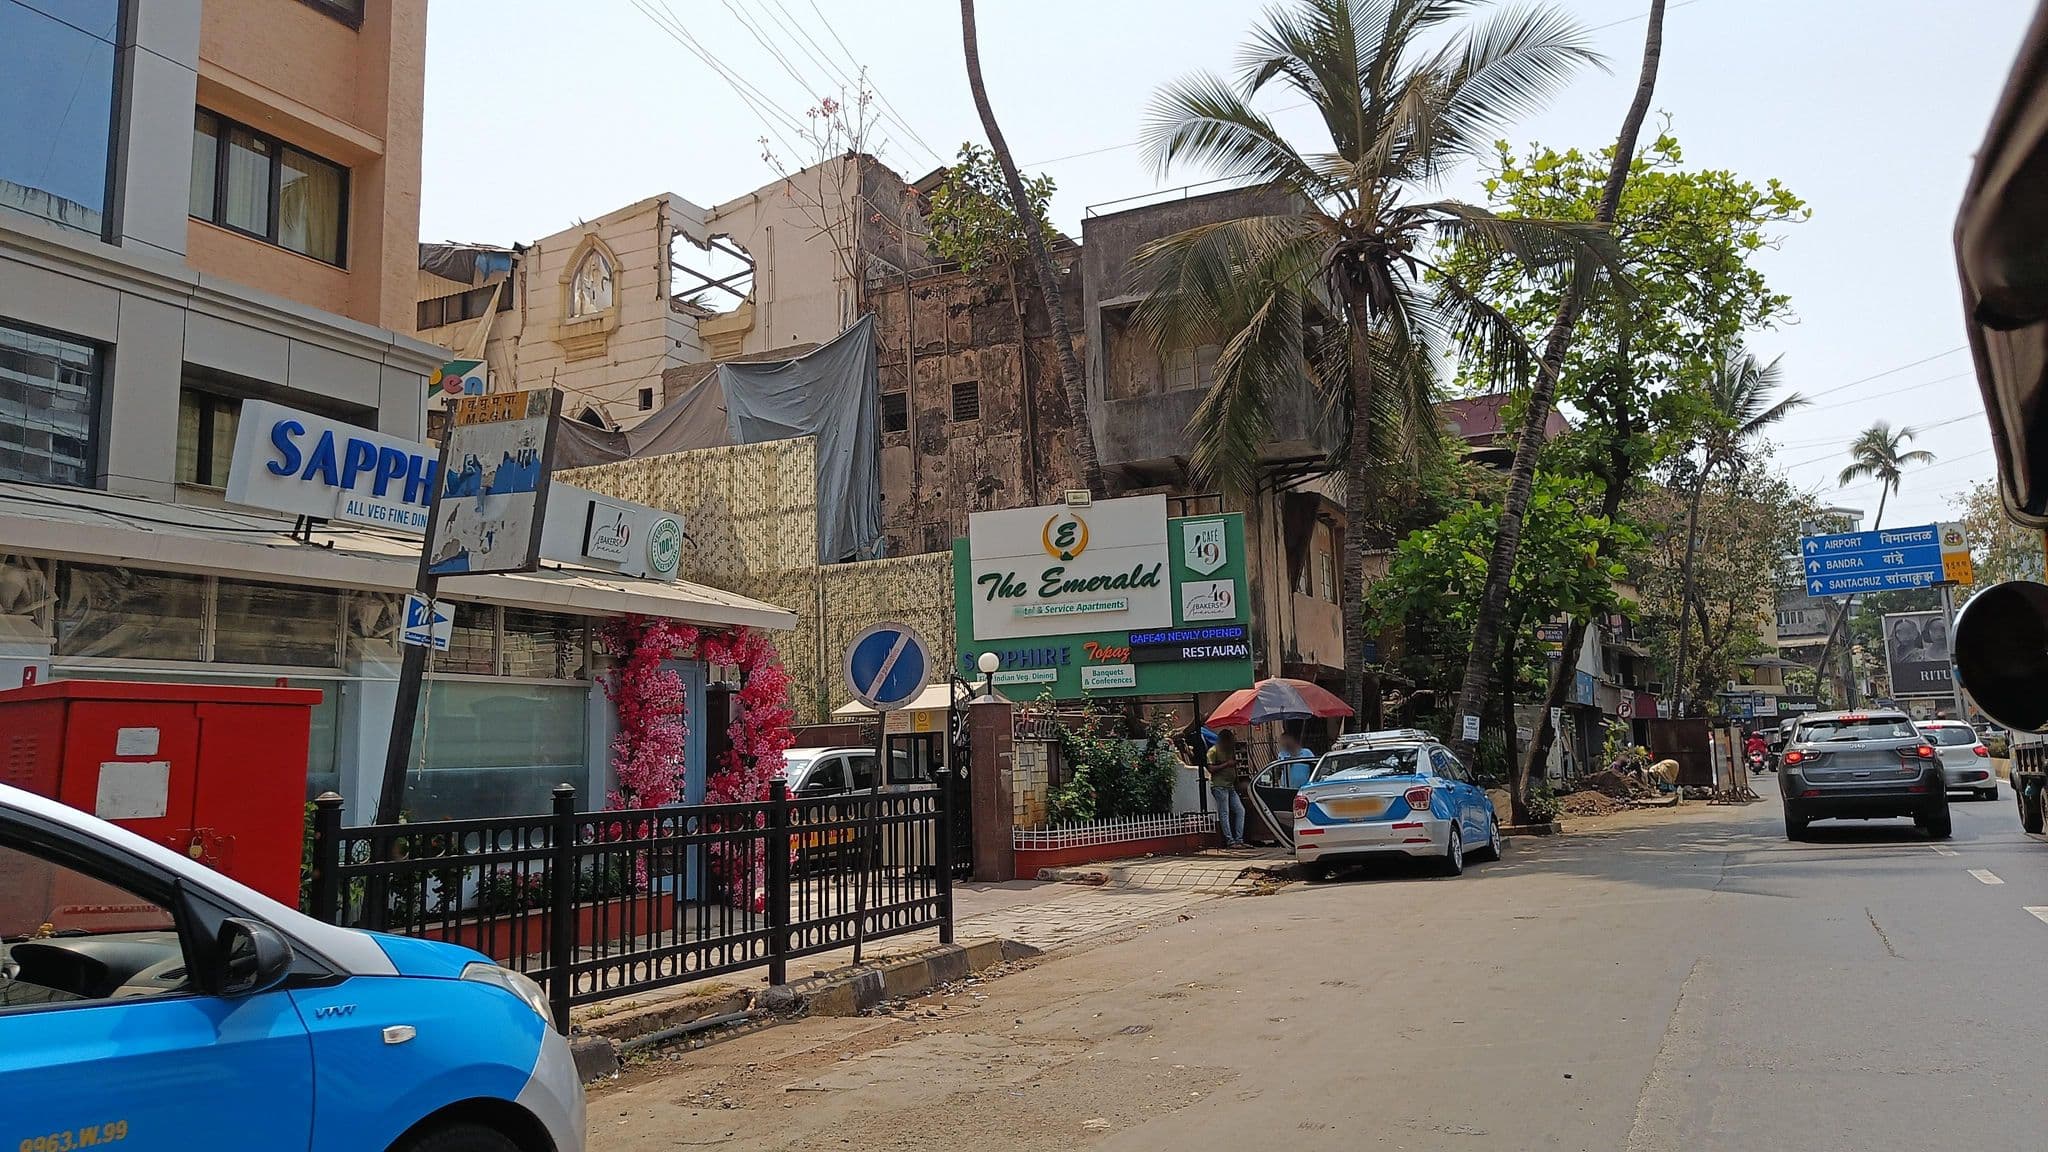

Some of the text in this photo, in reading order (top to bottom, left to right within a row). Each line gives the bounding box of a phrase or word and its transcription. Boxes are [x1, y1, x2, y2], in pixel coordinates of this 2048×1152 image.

[346, 500, 364, 516] ALL
[368, 504, 385, 520] VEG
[388, 508, 409, 524] FINE
[1055, 522, 1077, 547] E
[1880, 530, 1933, 544] विमानतळ
[1189, 535, 1219, 565] 49
[1824, 538, 1862, 550] AIRPORT
[1826, 558, 1864, 570] BANDRA
[978, 562, 1162, 601] The Emerald
[1829, 576, 1881, 590] SANTACRUZ
[1207, 583, 1231, 609] 49
[1045, 603, 1074, 615] Service
[1076, 600, 1124, 613] Apartments
[1131, 628, 1242, 644] CAFE49 NEWLY OPENED
[1083, 641, 1130, 663] Topaz
[1032, 671, 1054, 681] Dining
[1091, 677, 1133, 685] Conferences
[1092, 669, 1124, 679] Banquets
